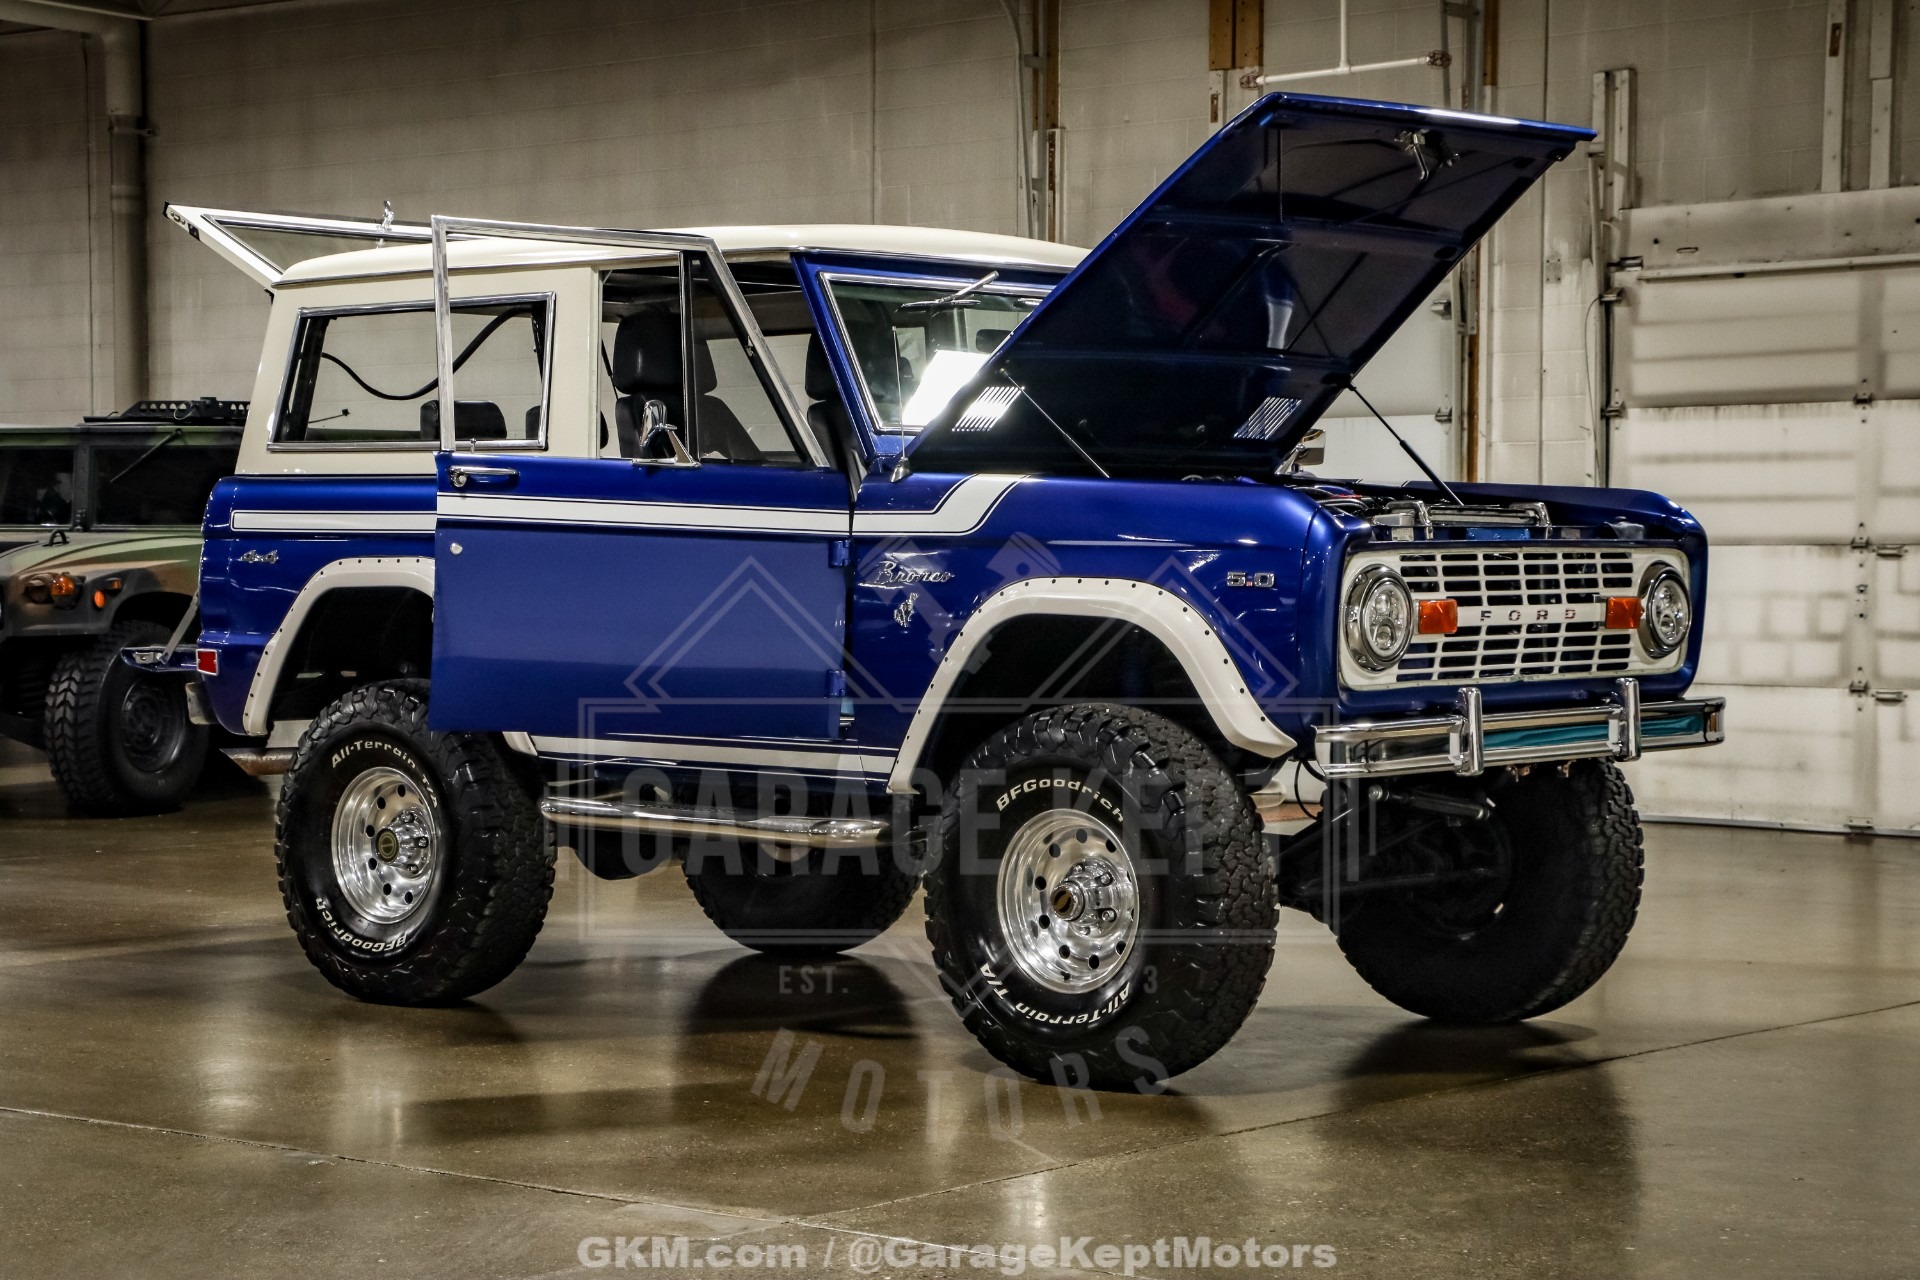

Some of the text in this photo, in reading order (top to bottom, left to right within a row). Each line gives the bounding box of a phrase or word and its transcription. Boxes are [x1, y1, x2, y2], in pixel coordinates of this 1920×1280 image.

[876, 560, 956, 584] Bronco
[1226, 571, 1275, 588] 5.0
[1480, 608, 1577, 621] FORD
[996, 779, 1124, 822] BFGoodrich
[316, 897, 407, 952] BFGoodrich
[980, 962, 1131, 1025] All-Terrain T/A
